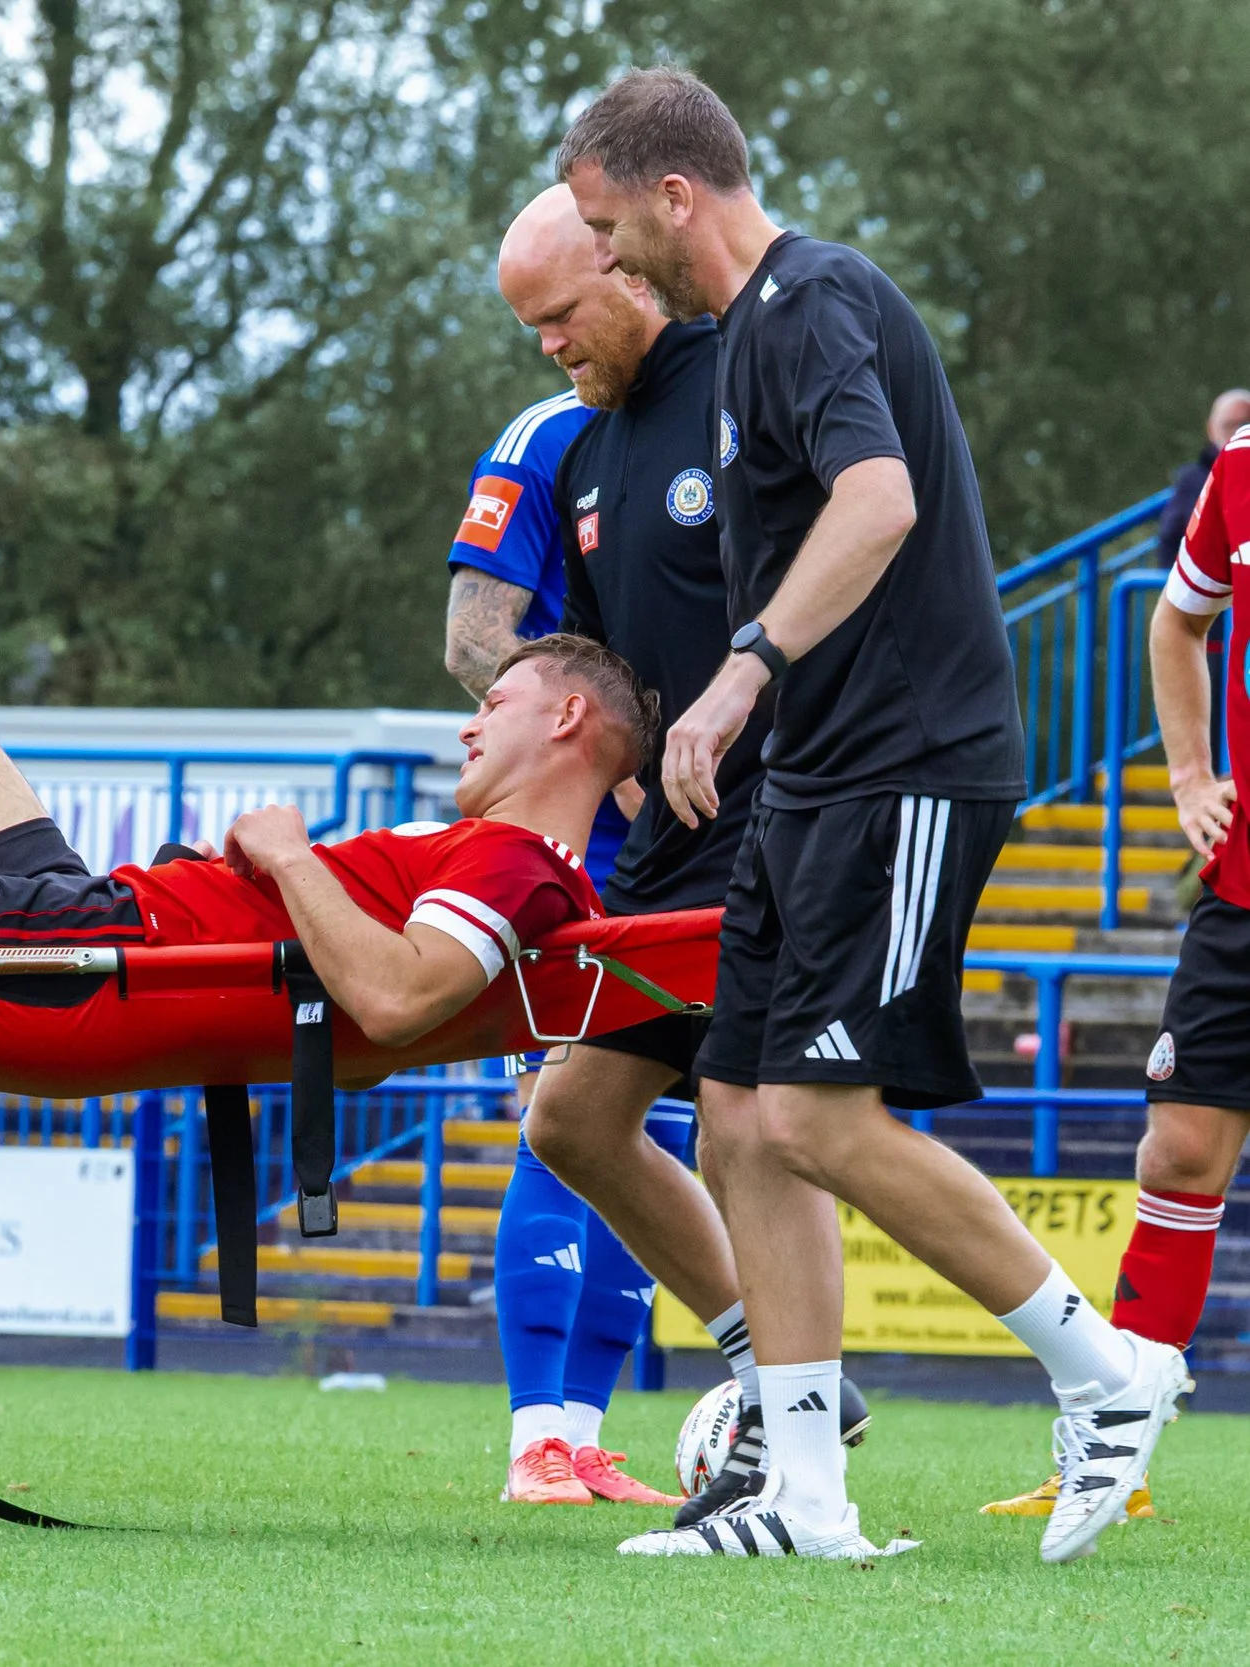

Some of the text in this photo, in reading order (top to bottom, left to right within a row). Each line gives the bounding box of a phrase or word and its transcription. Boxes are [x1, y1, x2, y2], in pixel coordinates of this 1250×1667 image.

[692, 471, 712, 490] ASHTON
[670, 501, 714, 523] FOOTBALL CLUB
[709, 1398, 736, 1449] Mitre
